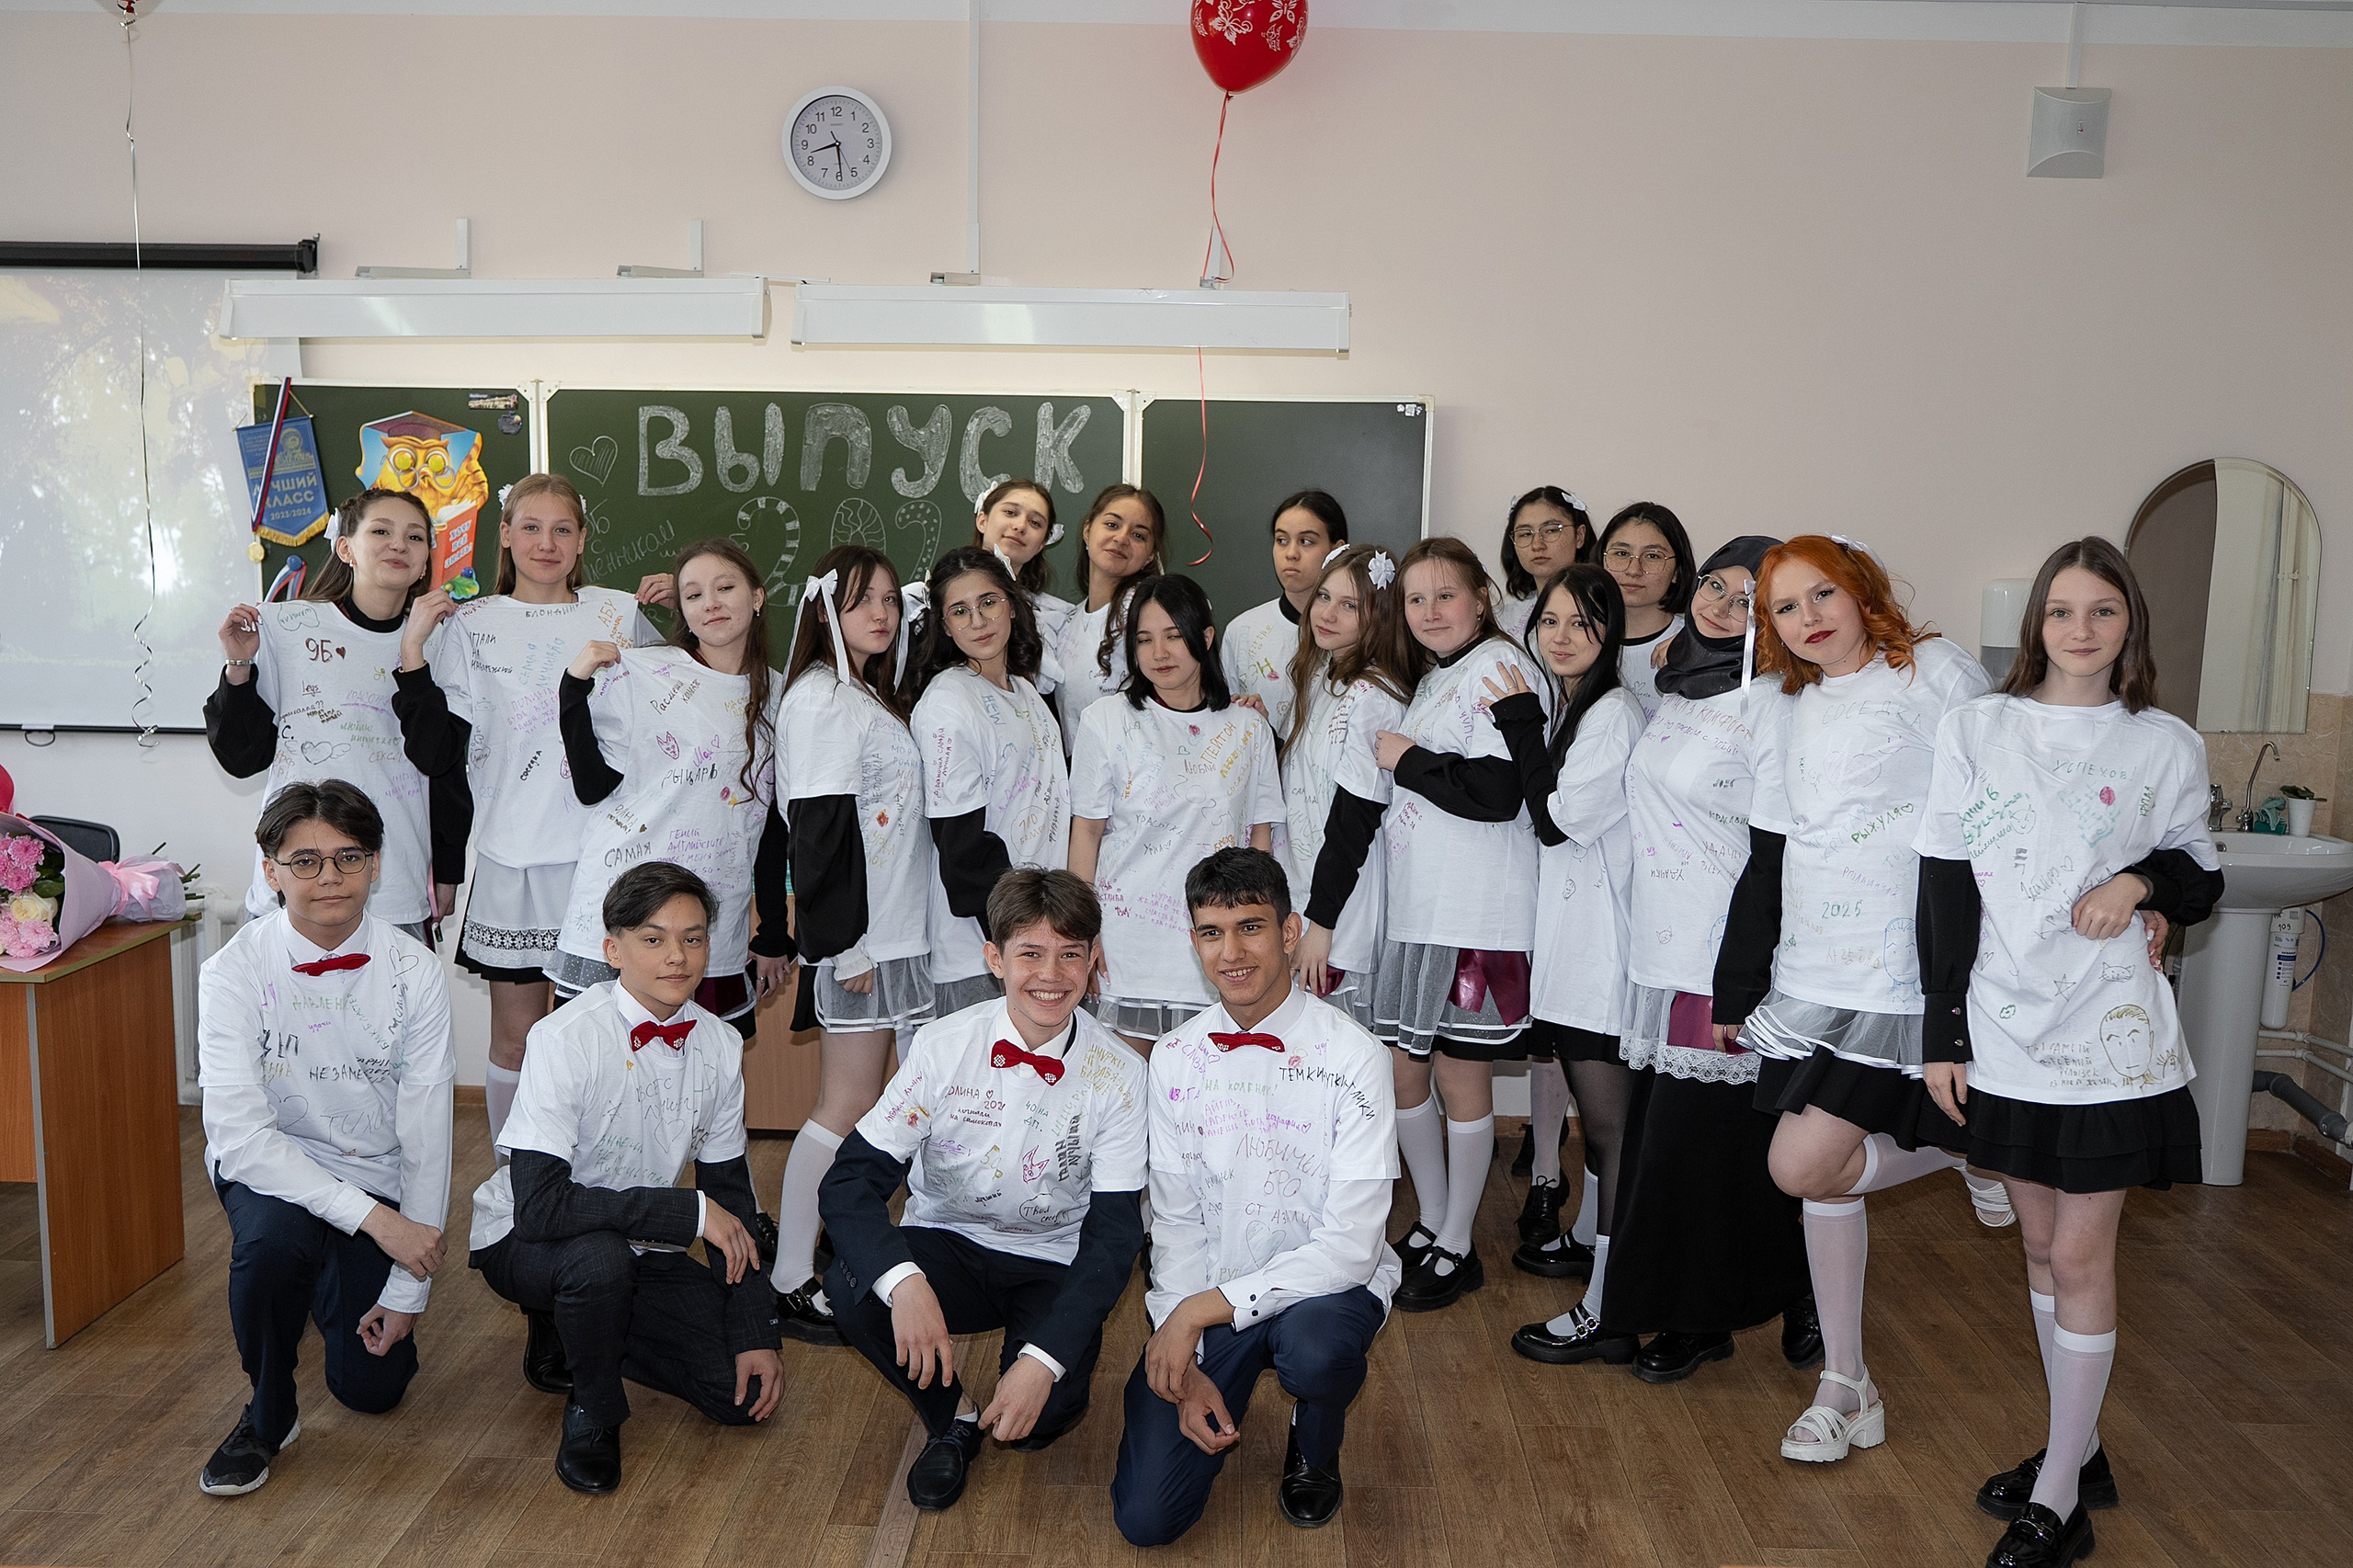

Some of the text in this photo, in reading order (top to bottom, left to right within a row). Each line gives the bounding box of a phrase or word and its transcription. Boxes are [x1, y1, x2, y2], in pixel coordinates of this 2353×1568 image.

[815, 112, 825, 121] 11
[831, 107, 842, 117] 12
[851, 111, 856, 121] 1
[806, 124, 817, 134] 10
[862, 123, 870, 133] 2
[801, 140, 808, 150] 9
[867, 139, 874, 149] 3
[807, 156, 814, 166] 8
[863, 154, 870, 165] 4
[821, 168, 828, 178] 7
[835, 172, 843, 182] 6
[851, 167, 858, 177] 5
[638, 402, 1092, 504] ВЫПУСК
[254, 472, 318, 496] ЛЧШИЙ
[597, 598, 618, 629] АБУ
[305, 637, 333, 663] 9Б
[1822, 699, 1923, 730] СОСЕДКА
[1199, 721, 1237, 765] ПЕЙТОН
[2052, 759, 2138, 781] УСПЕХОВ!
[1850, 806, 1903, 845] РЫЖУЛЯ
[1821, 899, 1864, 920] 2025
[946, 1085, 980, 1100] ОЛИНА
[1263, 1169, 1302, 1198] БРО
[1245, 1202, 1266, 1216] ОТ
